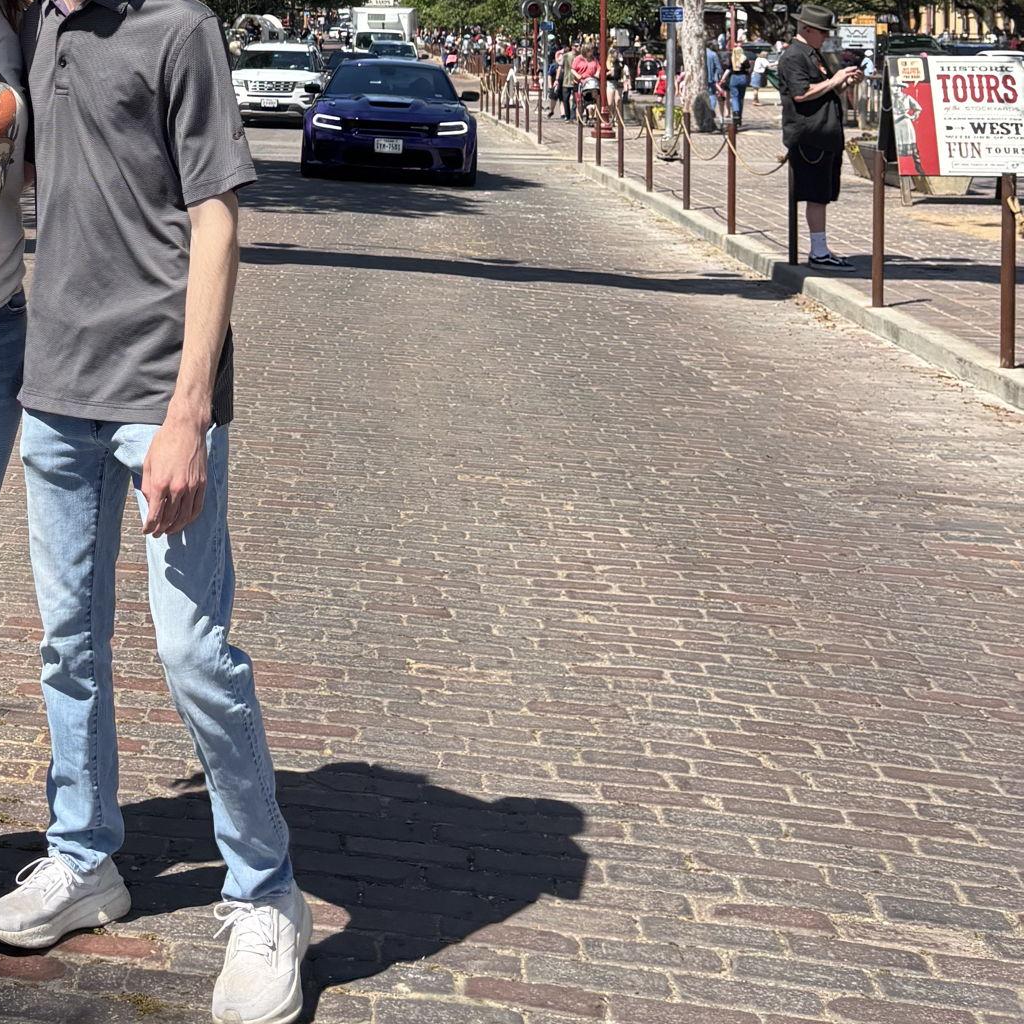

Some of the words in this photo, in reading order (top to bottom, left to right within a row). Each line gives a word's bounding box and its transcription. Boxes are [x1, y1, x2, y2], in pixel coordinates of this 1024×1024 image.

[940, 65, 1014, 73] HISTORIC
[937, 74, 1018, 104] TOURS
[969, 122, 1023, 136] WEST
[945, 142, 982, 159] FUN
